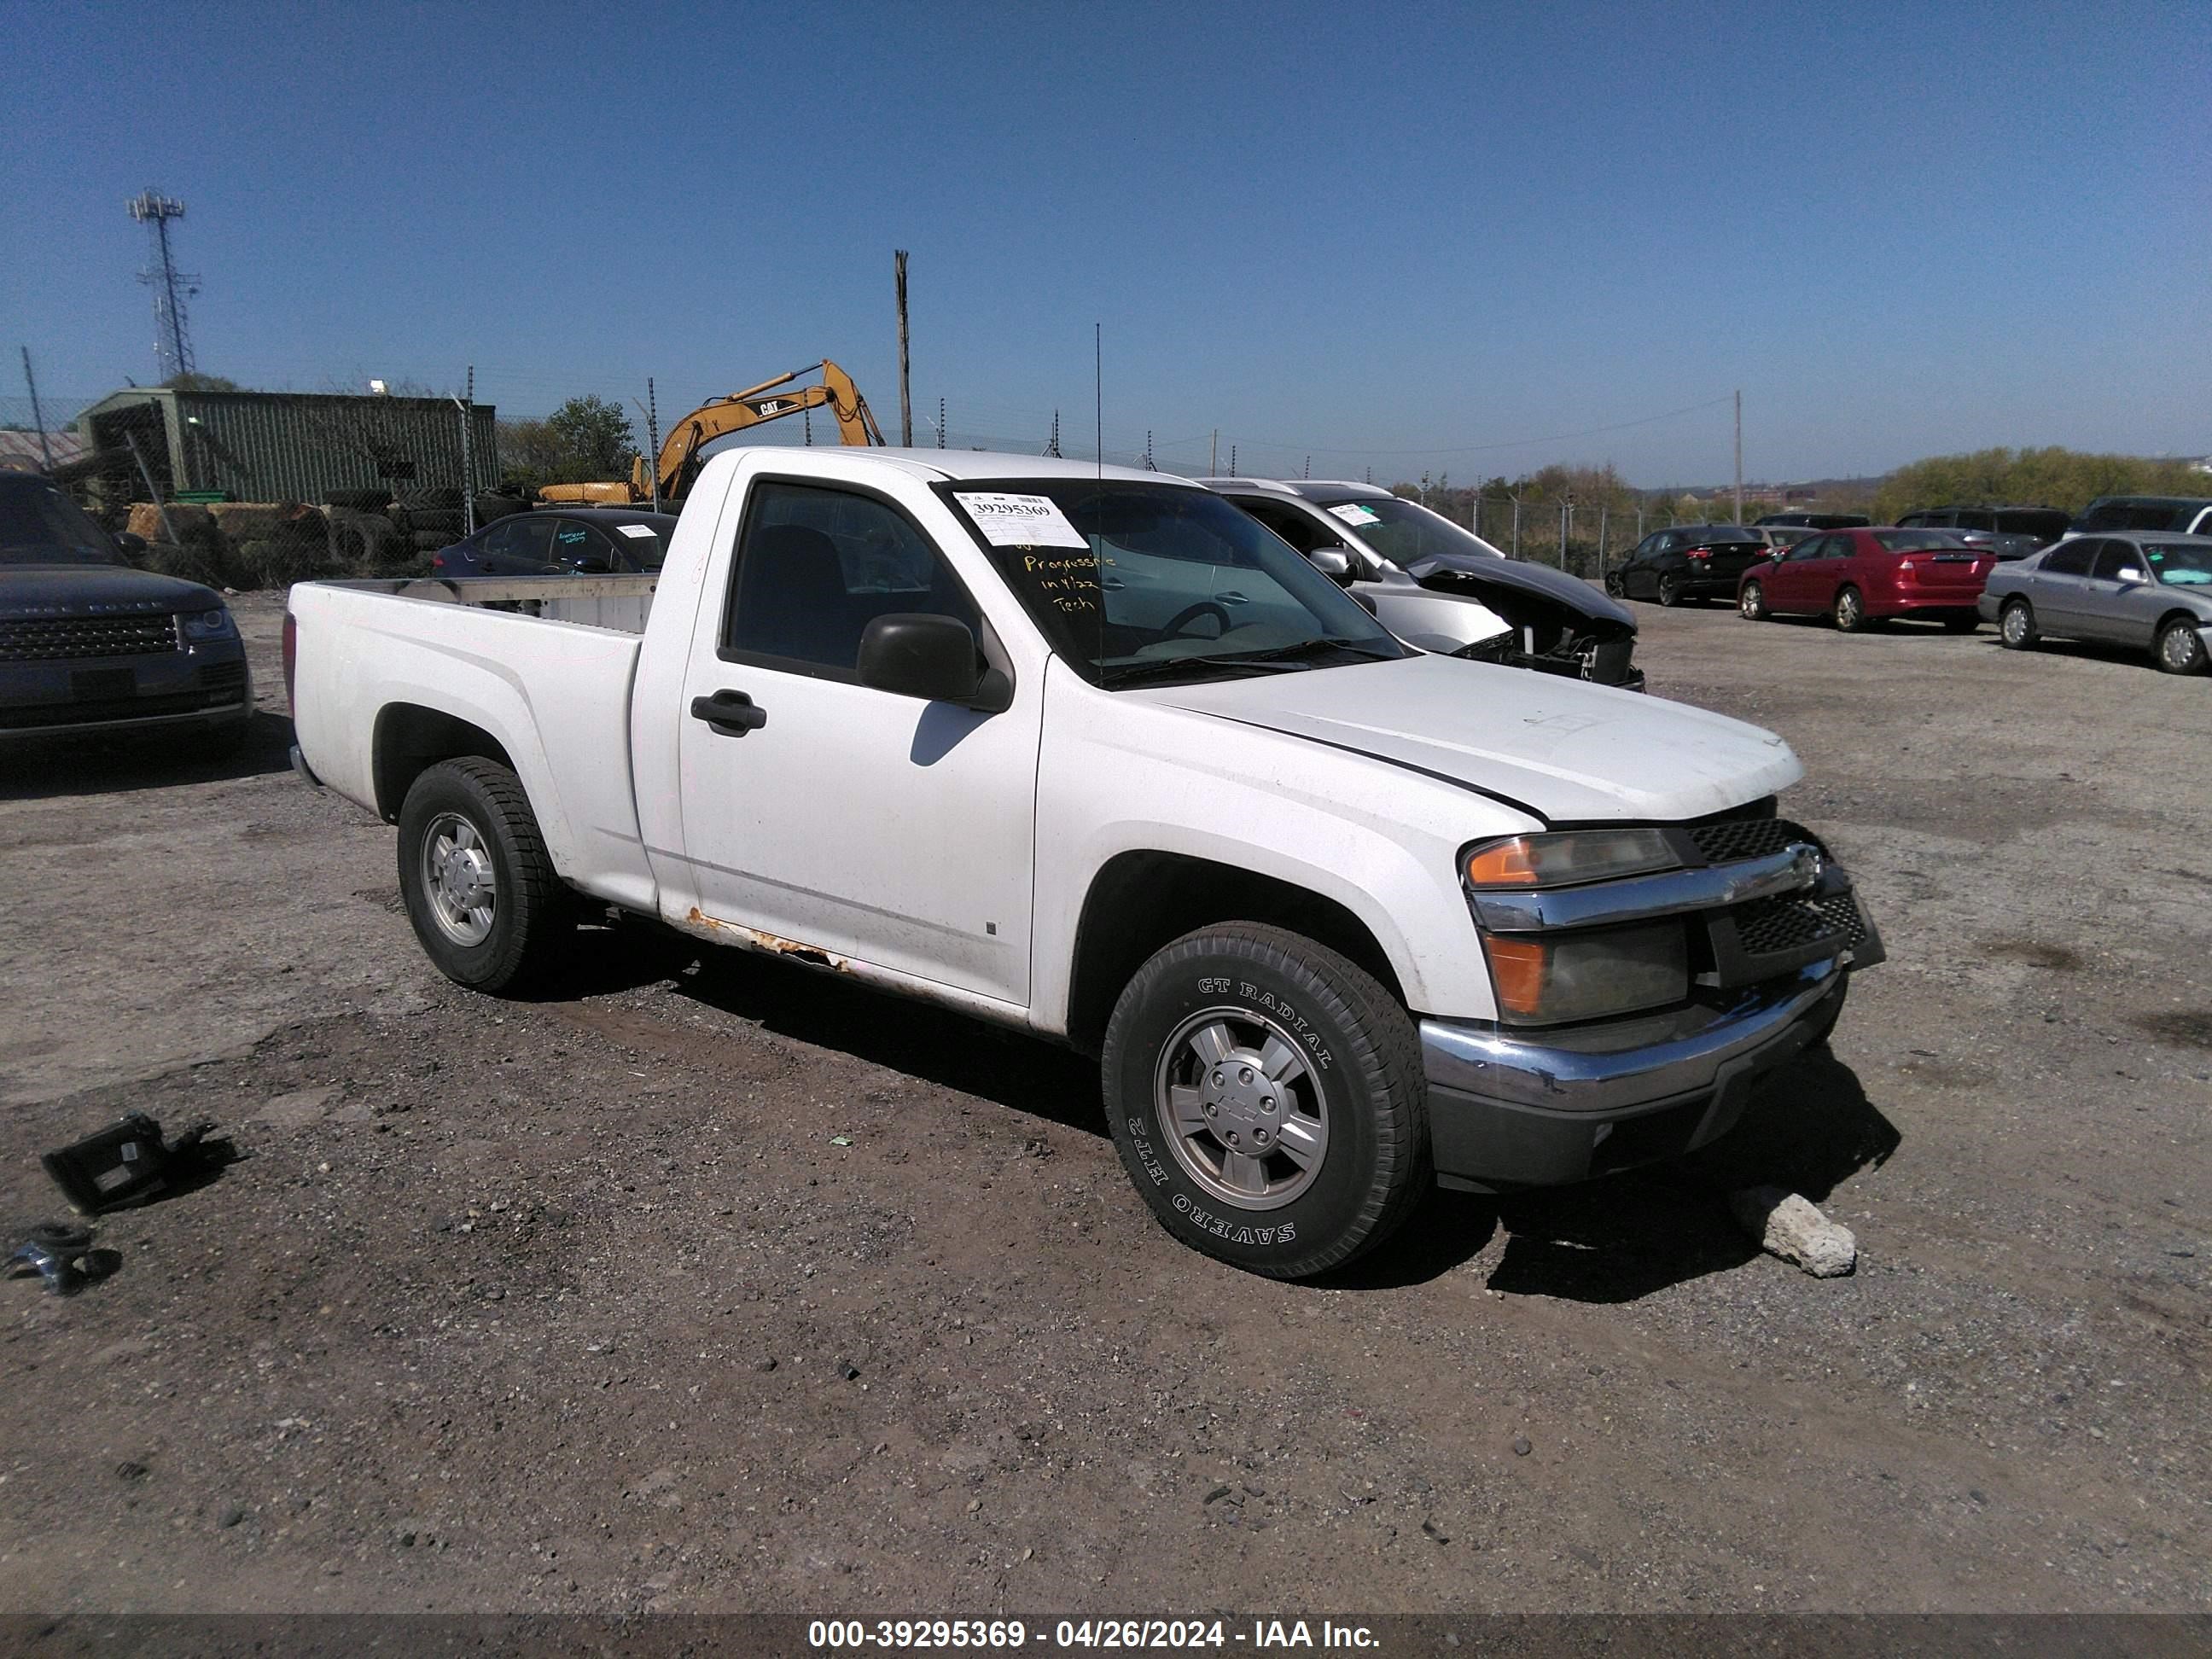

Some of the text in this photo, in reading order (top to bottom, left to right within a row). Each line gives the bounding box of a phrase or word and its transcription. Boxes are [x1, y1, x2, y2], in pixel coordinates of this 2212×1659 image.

[760, 400, 778, 416] CAT
[973, 503, 1051, 516] 39295369
[1052, 597, 1096, 613] Tech
[1197, 978, 1332, 1070] GT RADIAL
[1127, 1117, 1297, 1245] SAVERO HT2
